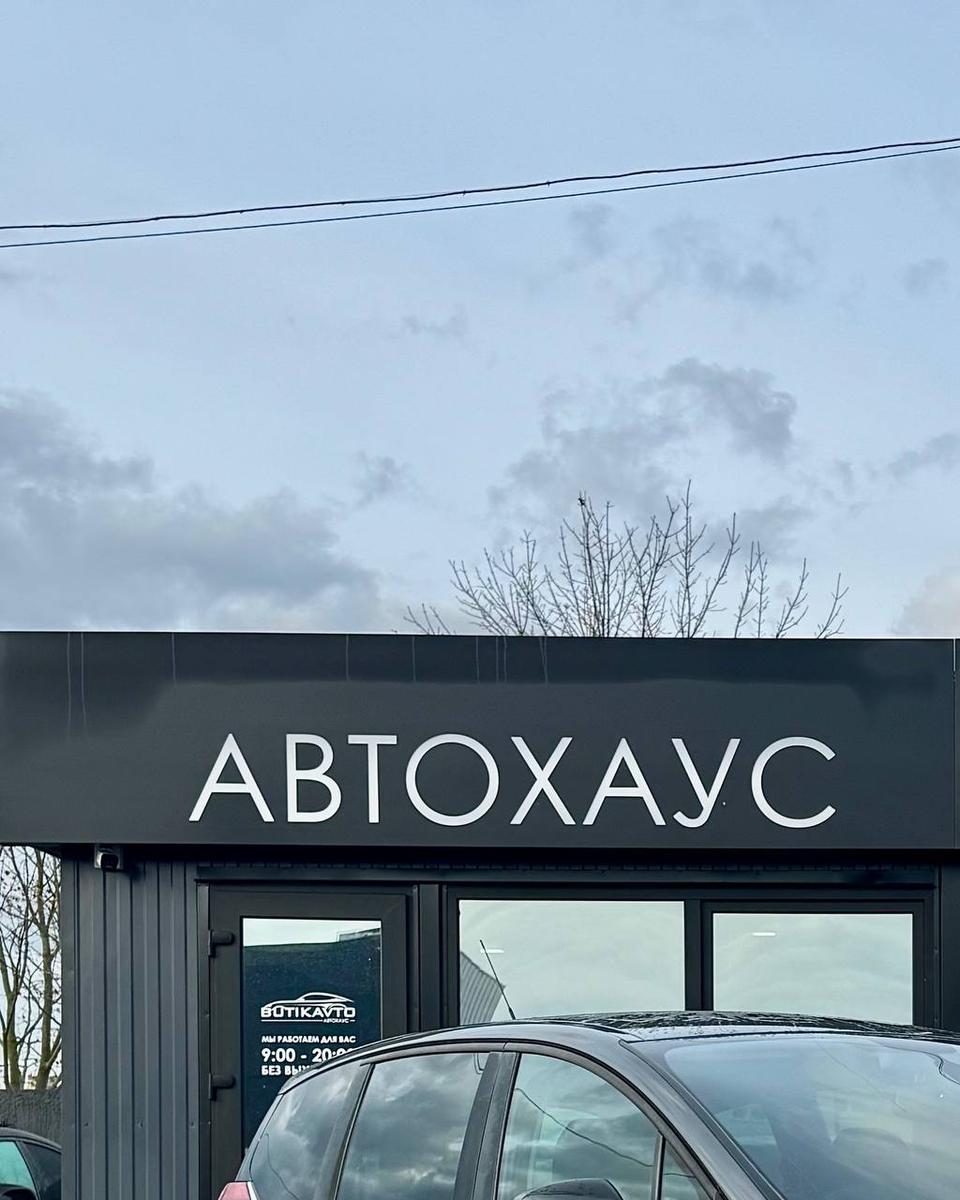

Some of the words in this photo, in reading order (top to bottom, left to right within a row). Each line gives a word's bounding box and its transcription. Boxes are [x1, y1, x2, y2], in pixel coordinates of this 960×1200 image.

[189, 733, 837, 829] АВТОХАУС
[261, 1007, 355, 1018] BUTIKAVTO
[262, 1035, 276, 1043] МЫ
[278, 1035, 319, 1043] РАБОТАЕМ
[320, 1036, 337, 1044] ДЛЯ
[339, 1035, 356, 1043] ВАС
[261, 1048, 296, 1063] 9:00
[312, 1048, 355, 1063] 20:
[261, 1065, 281, 1076] БЕЗ
